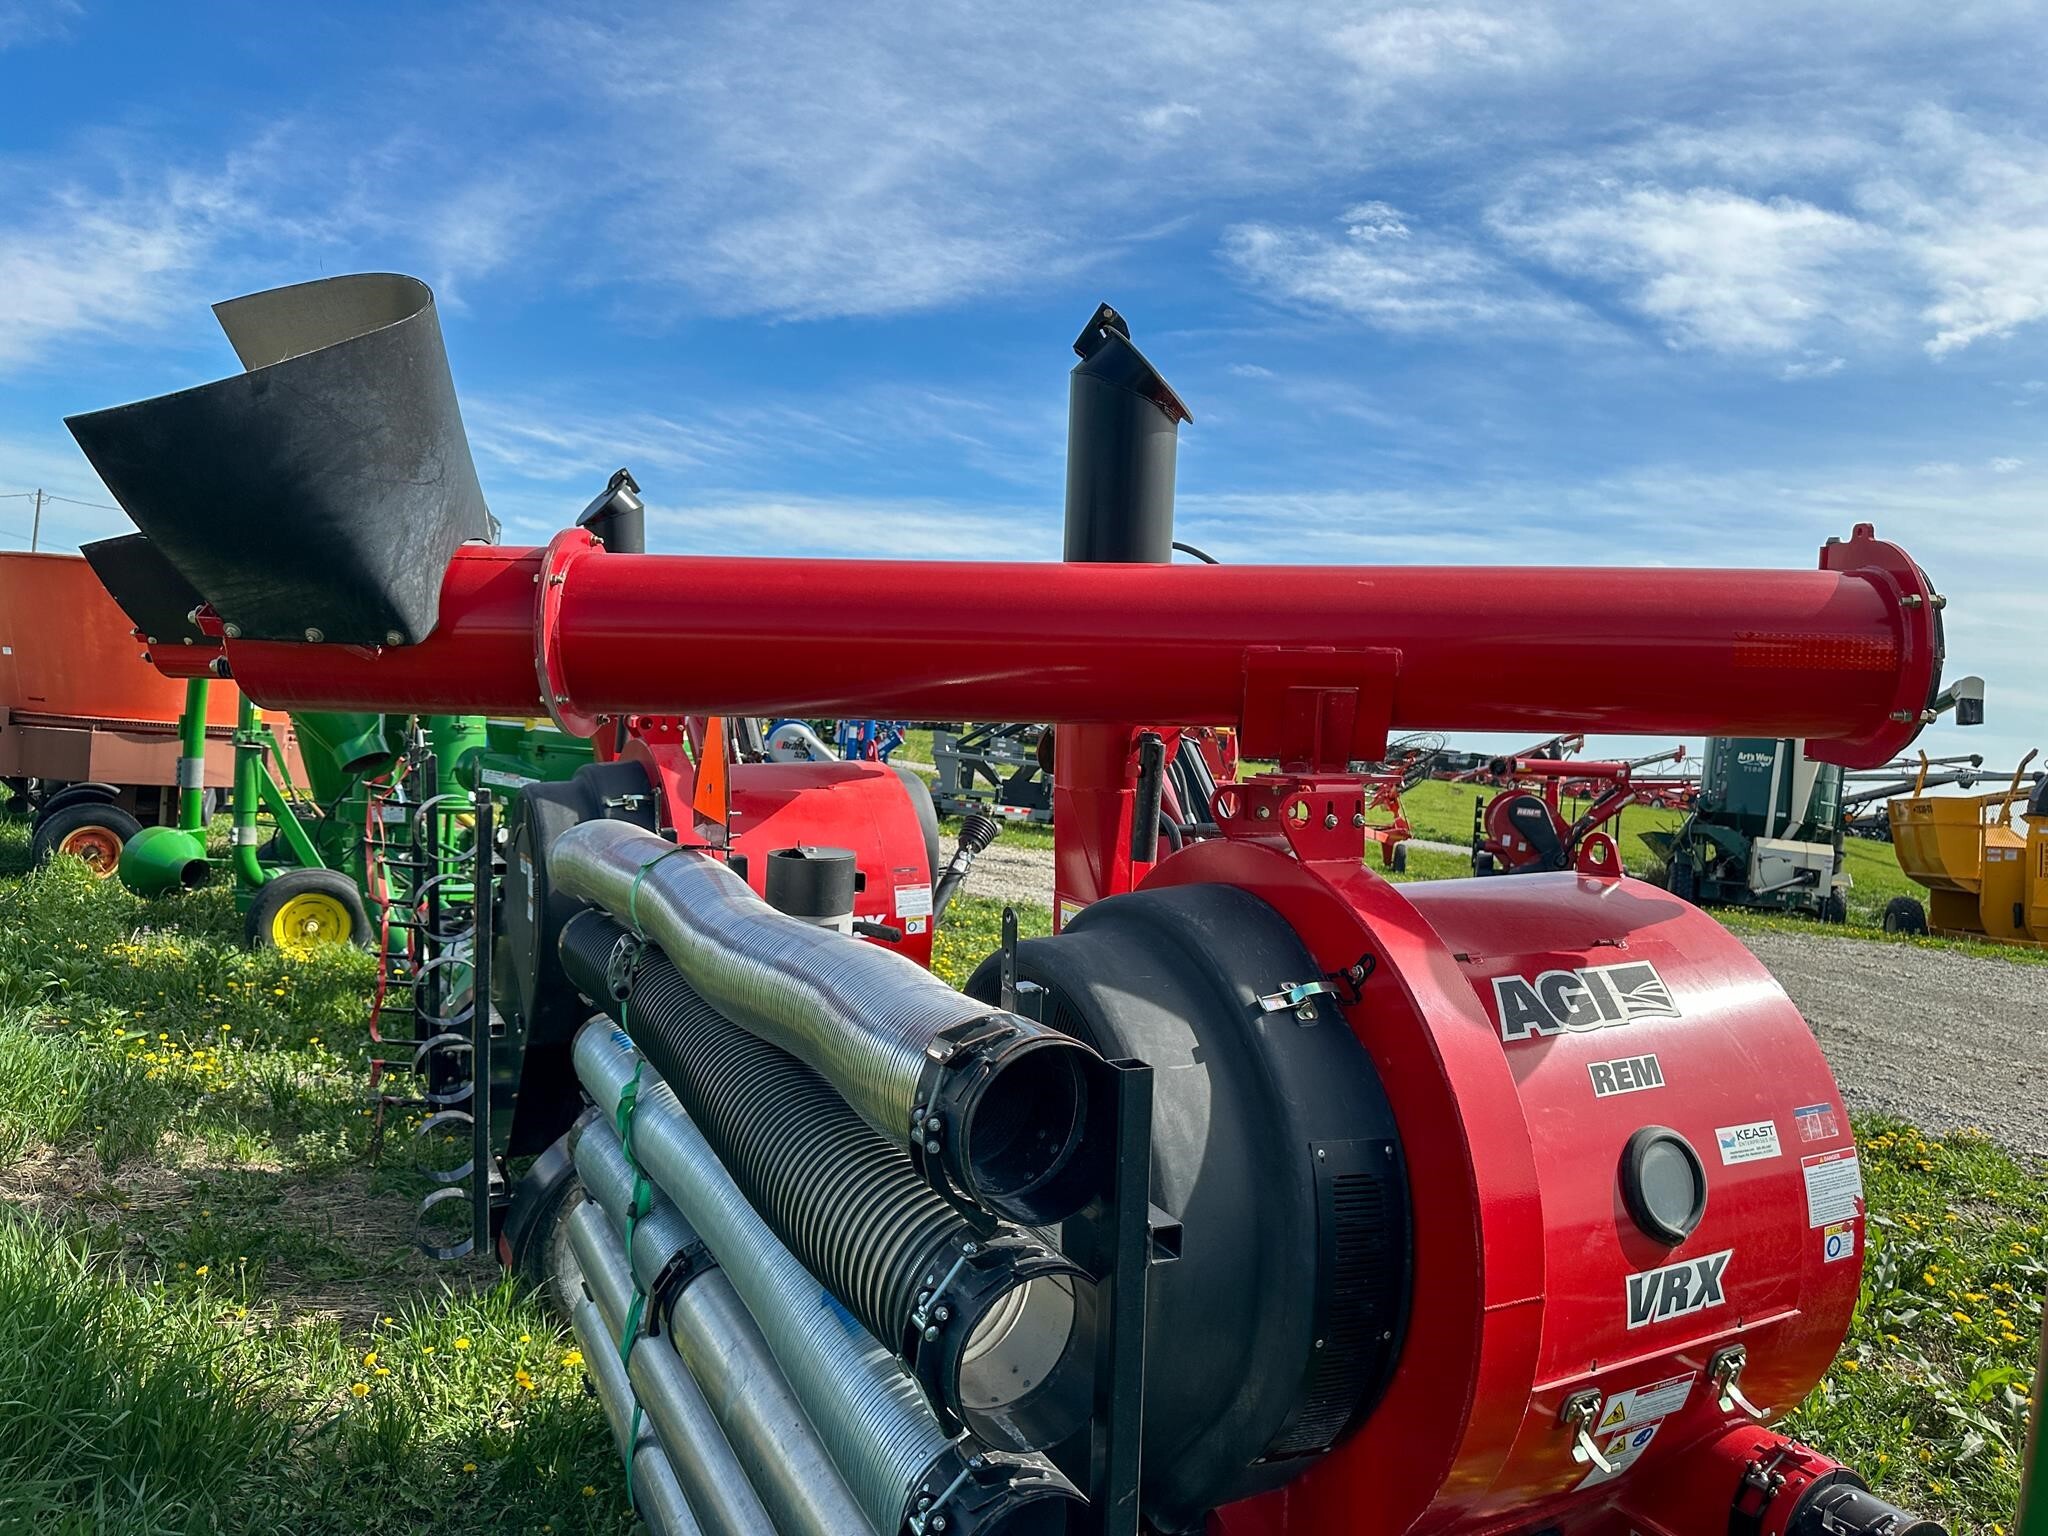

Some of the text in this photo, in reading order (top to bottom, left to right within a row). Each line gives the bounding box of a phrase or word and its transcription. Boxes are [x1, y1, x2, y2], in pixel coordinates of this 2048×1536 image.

[1755, 752, 1774, 763] Way
[1496, 970, 1624, 1036] AGI
[1589, 1056, 1663, 1095] REM
[1735, 1125, 1773, 1141] KEAST
[1823, 1153, 1841, 1163] DANGER
[1629, 1254, 1729, 1325] VRX
